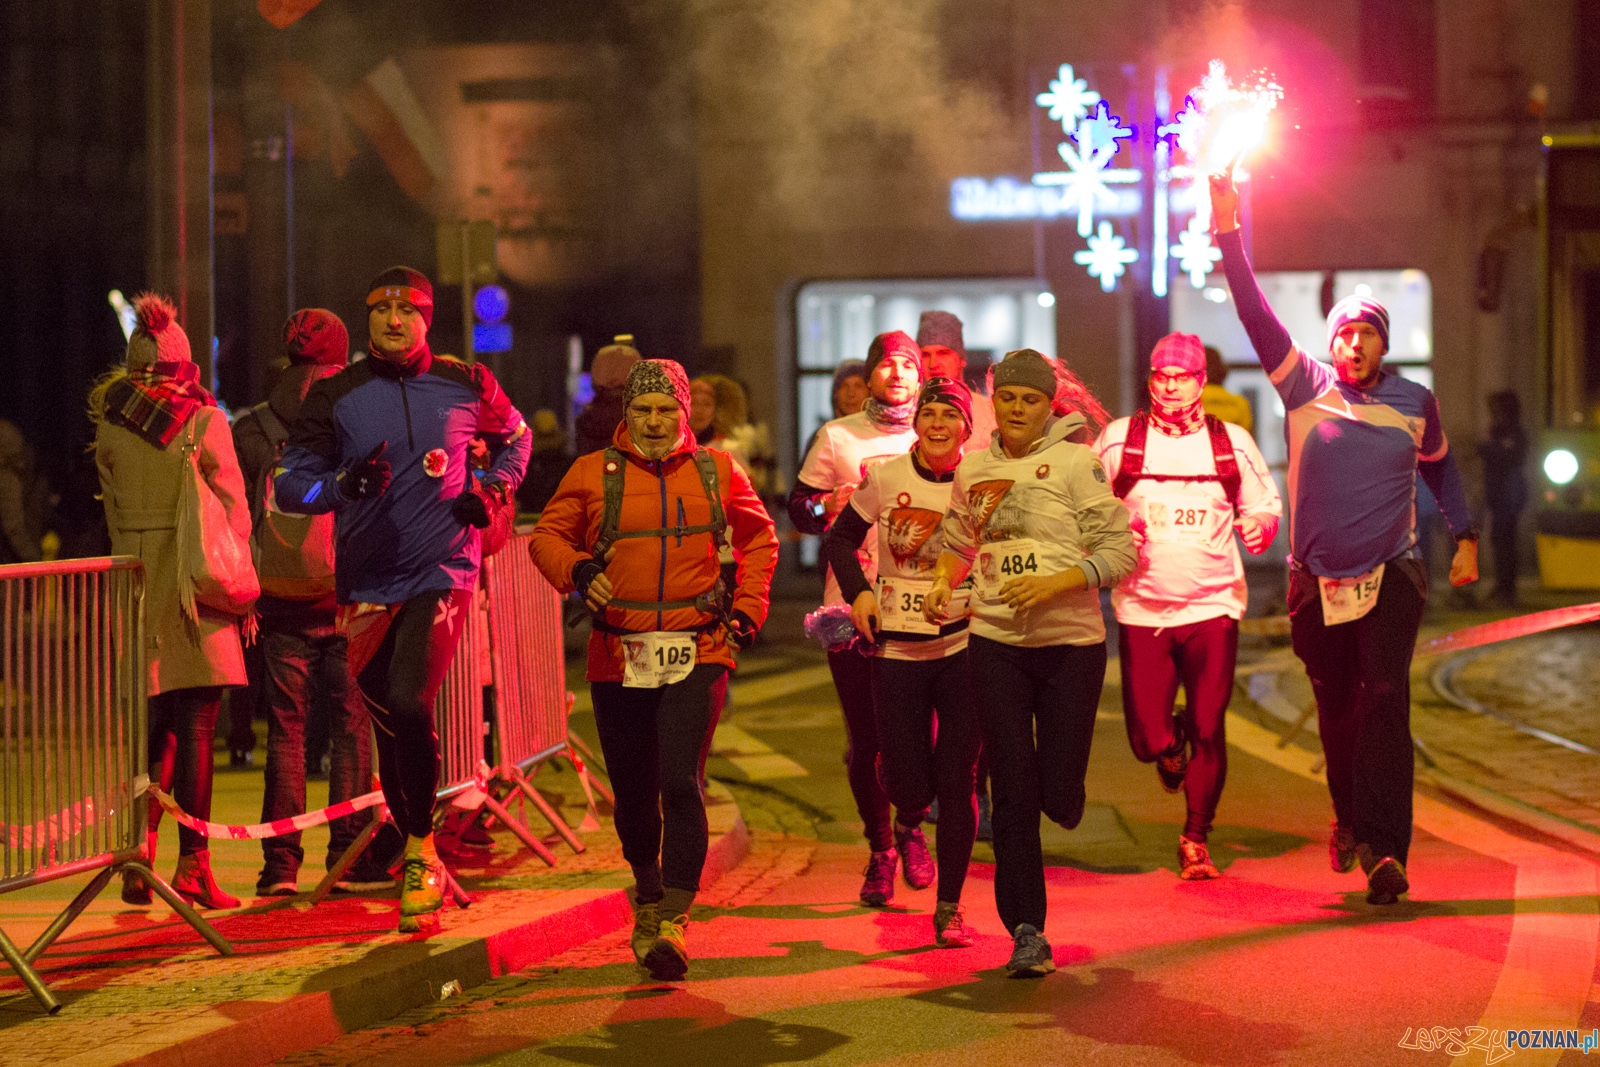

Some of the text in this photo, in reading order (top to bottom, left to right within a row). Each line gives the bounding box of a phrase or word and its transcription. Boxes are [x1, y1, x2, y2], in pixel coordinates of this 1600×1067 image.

[1174, 508, 1207, 525] 287
[1001, 552, 1038, 575] 484
[655, 646, 691, 666] 105
